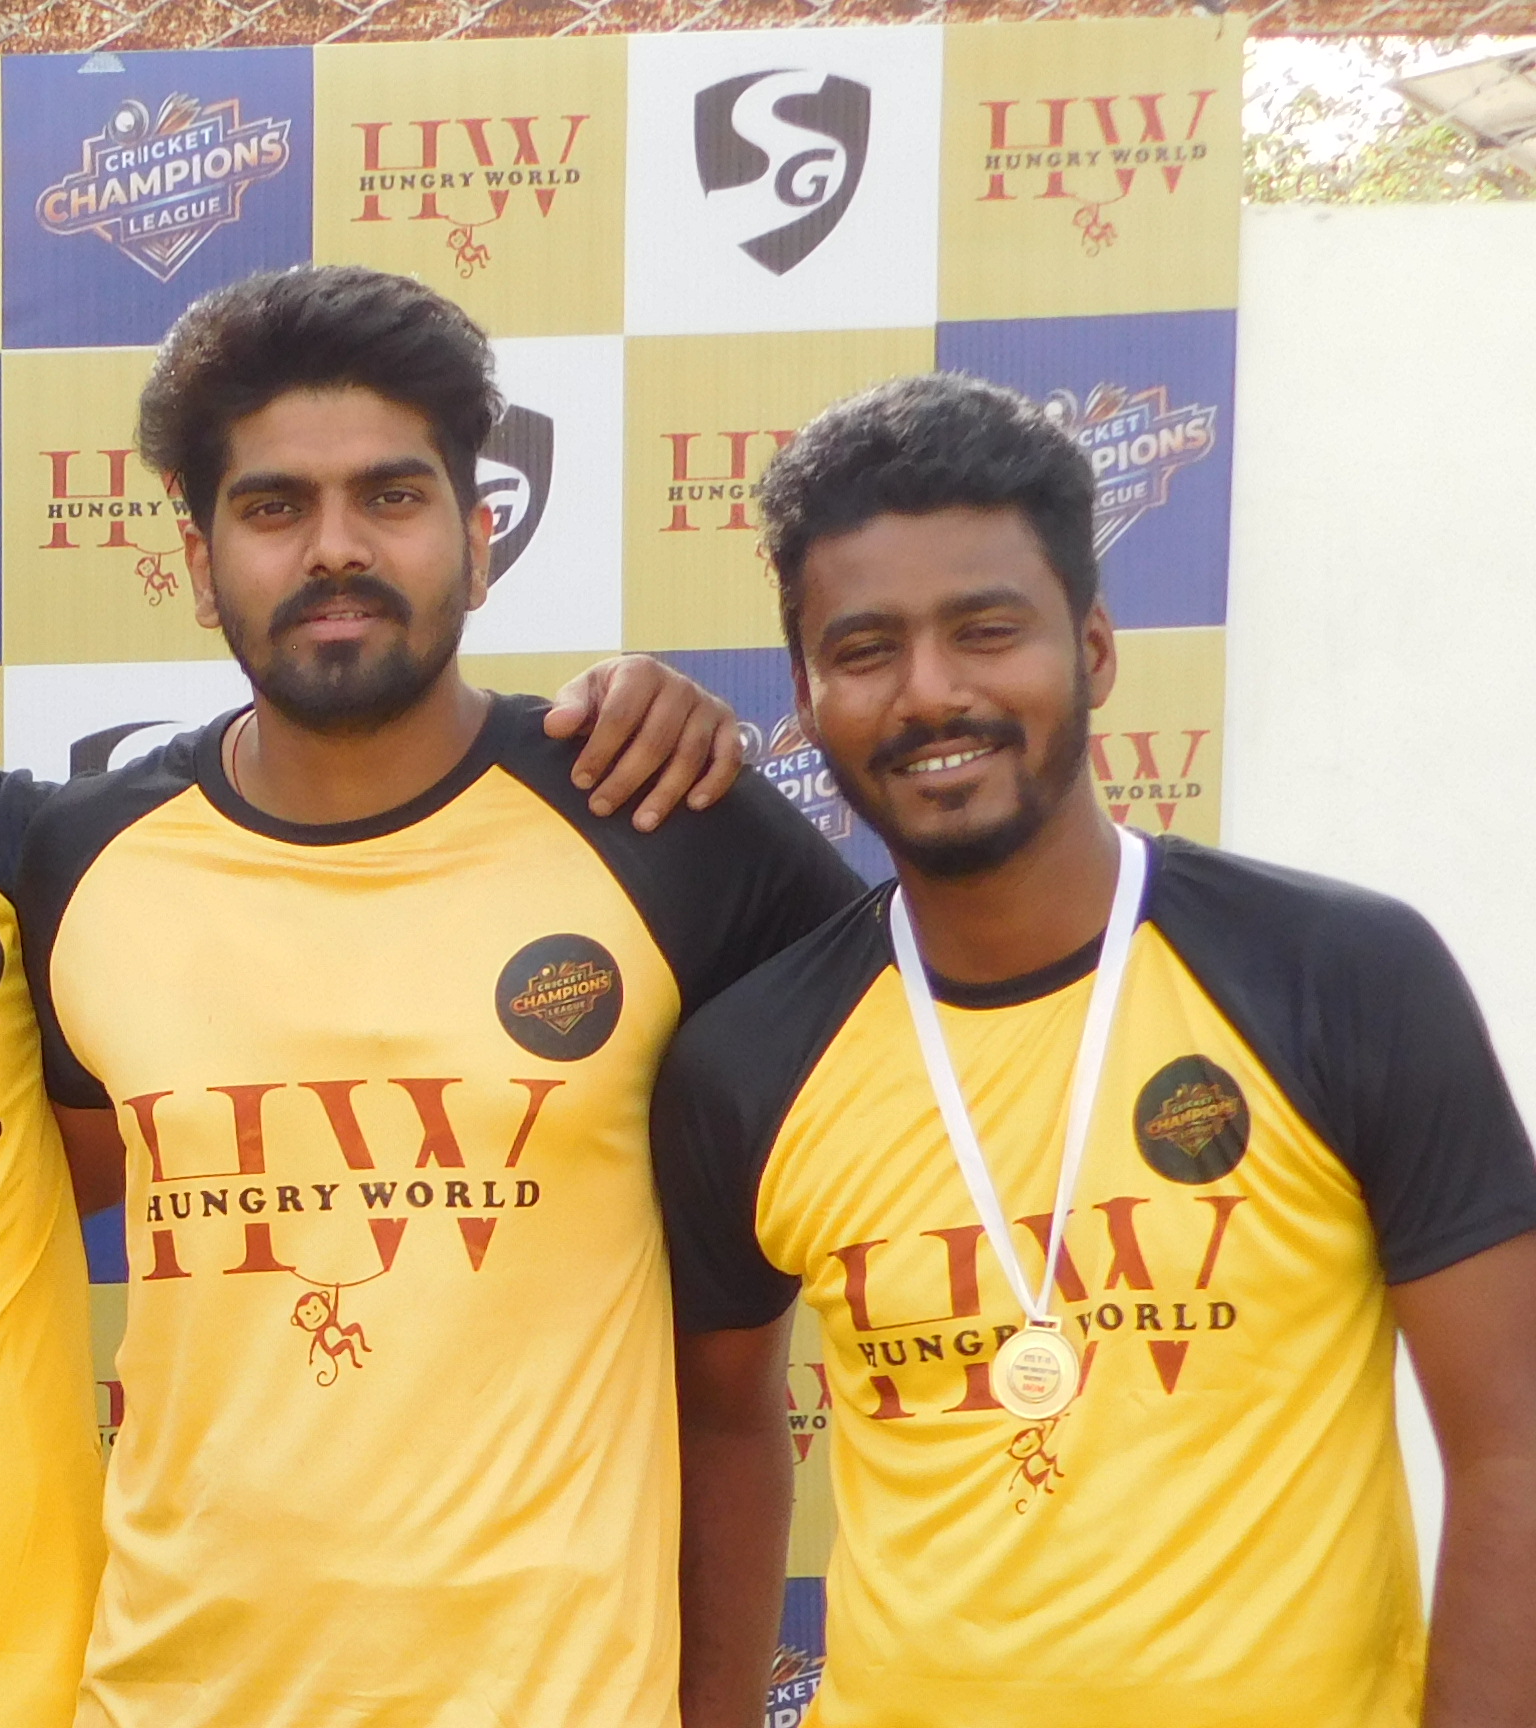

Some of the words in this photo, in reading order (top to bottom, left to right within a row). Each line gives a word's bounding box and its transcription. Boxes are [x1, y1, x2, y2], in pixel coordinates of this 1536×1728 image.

[977, 88, 1218, 201] HW
[985, 149, 1102, 171] HUNGRY
[1111, 144, 1207, 165] WORLD
[44, 130, 282, 223] CHAMPIONS
[350, 115, 590, 222] HW
[359, 172, 473, 192] HUNGRY
[483, 168, 580, 187] WORLD
[129, 195, 221, 234] LEAGUE
[1078, 413, 1141, 448] CKET
[1091, 418, 1206, 474] PIONS
[48, 501, 162, 519] HUNGRY
[668, 484, 757, 501] HUNG
[1099, 481, 1148, 507] GUE
[1103, 782, 1202, 801] WORLD
[513, 975, 609, 1011] CHAMPIONS
[548, 1000, 585, 1016] LEAGUE
[122, 1077, 566, 1281] HW
[147, 1183, 339, 1222] HUNGRY
[358, 1179, 540, 1210] WORLD
[858, 1324, 1019, 1368] HUNGR
